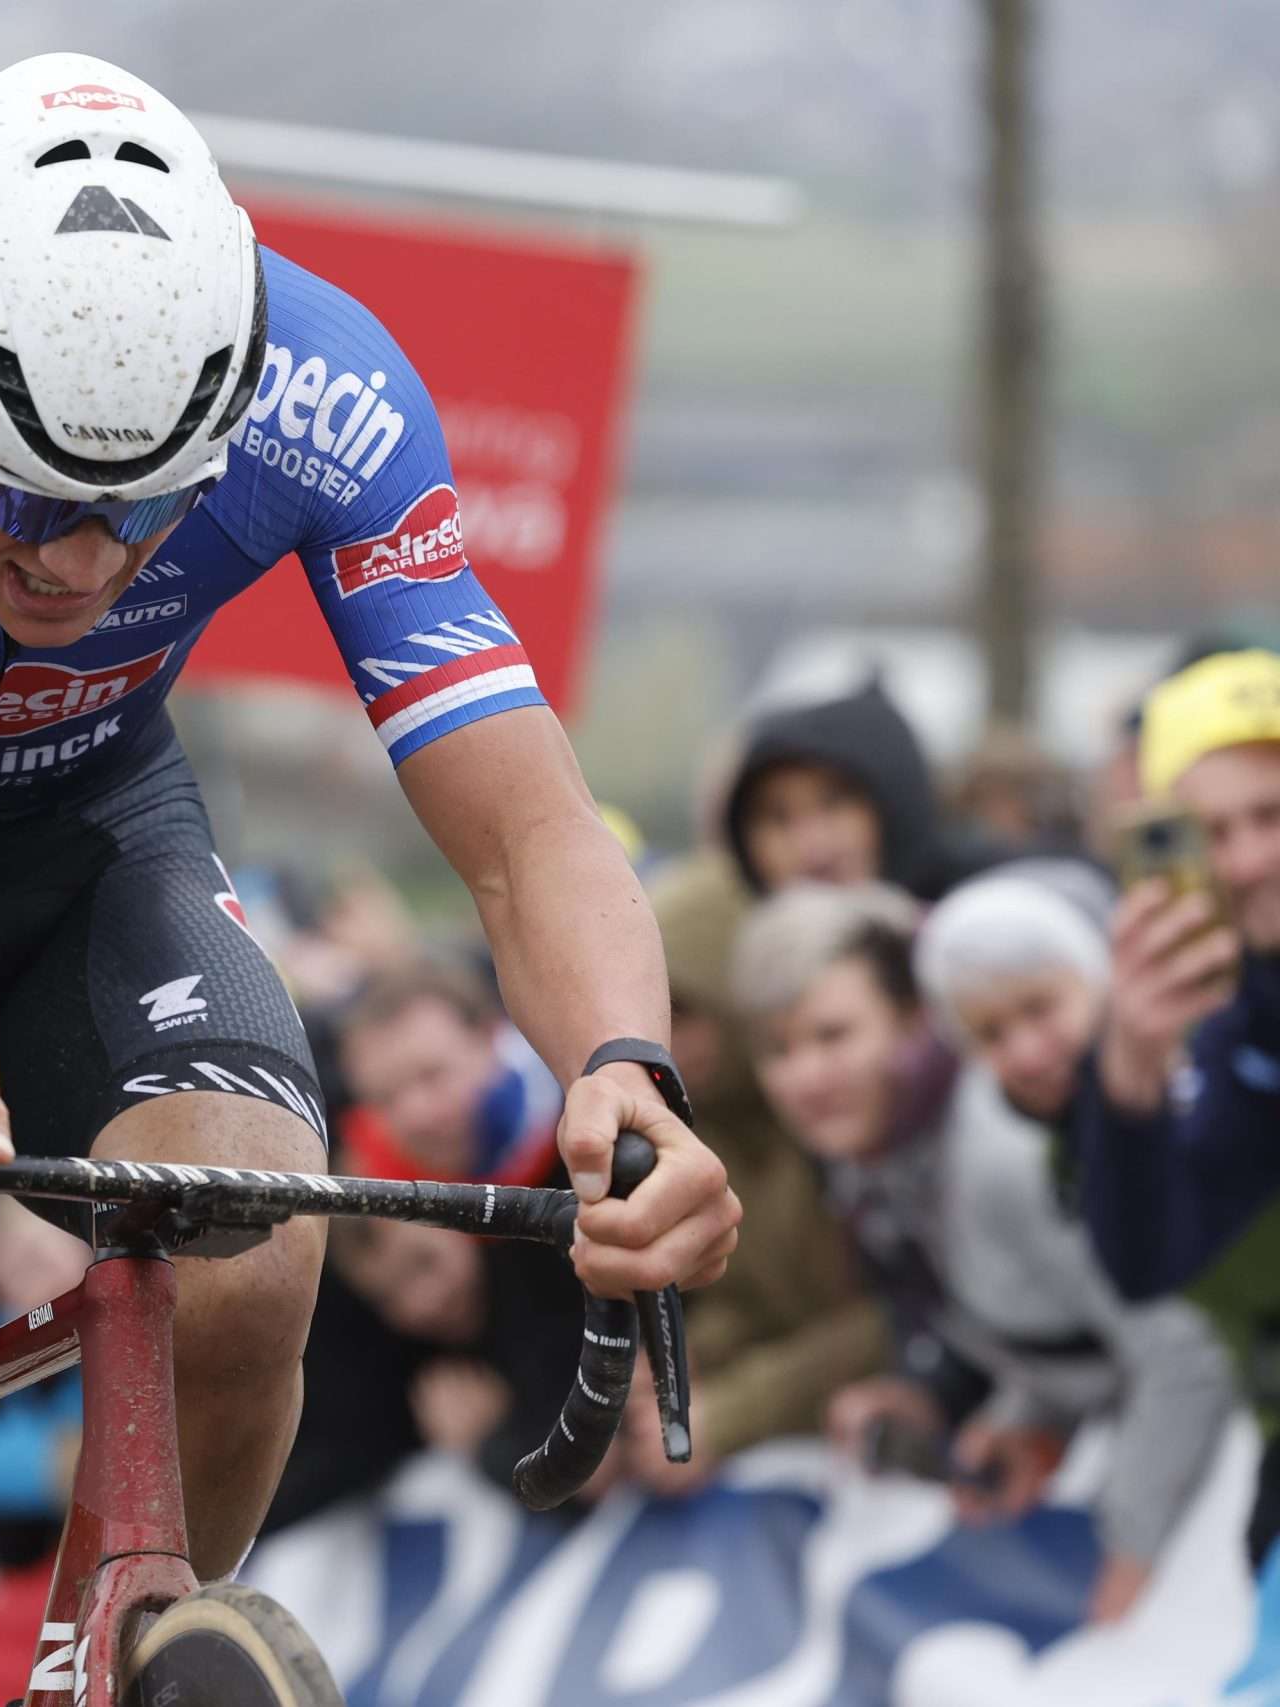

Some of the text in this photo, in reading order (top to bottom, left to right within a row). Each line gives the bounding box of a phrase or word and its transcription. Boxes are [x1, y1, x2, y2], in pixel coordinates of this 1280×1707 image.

[53, 90, 138, 108] Alpecin
[231, 342, 405, 481] pecin
[244, 426, 361, 506] BOOSTER
[363, 557, 413, 580] HAIR
[100, 601, 182, 630] AUTO
[153, 1012, 208, 1033] ZWIFT
